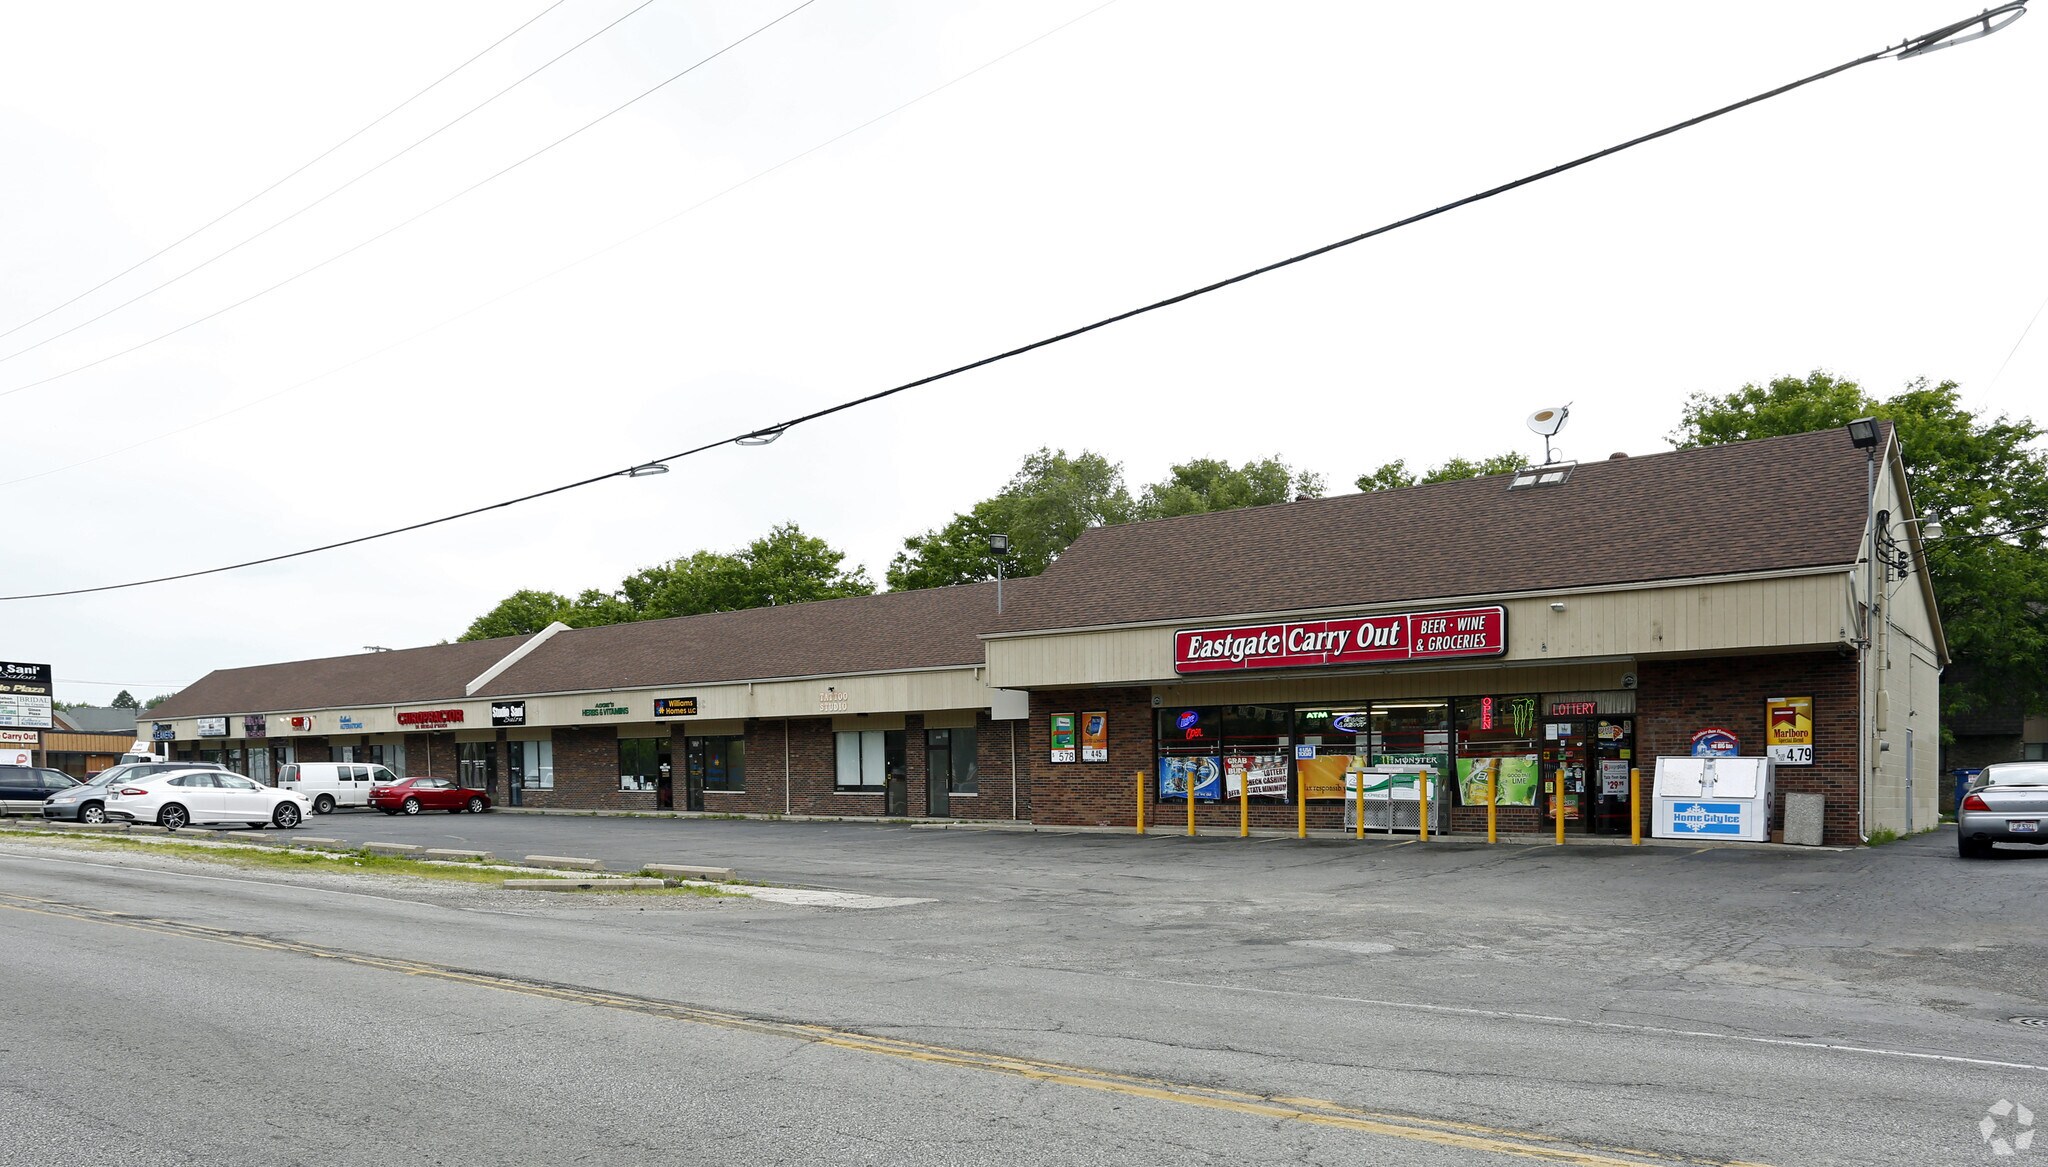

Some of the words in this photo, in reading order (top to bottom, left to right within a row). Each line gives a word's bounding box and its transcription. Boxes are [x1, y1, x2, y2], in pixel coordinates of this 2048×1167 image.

[1421, 618, 1447, 634] BEER
[1457, 615, 1486, 631] WINE
[1187, 631, 1280, 662] Eastgate
[1288, 627, 1351, 655] Carry
[1357, 620, 1401, 648] Out
[1416, 638, 1424, 652] &
[1428, 633, 1487, 651] GROCERIES
[13, 684, 46, 693] Plaza
[820, 692, 848, 701] TATTOO
[603, 707, 629, 716] VITAMINS
[665, 707, 687, 715] Homes
[820, 703, 848, 711] STUDIO
[1552, 702, 1596, 716] LOTTERY
[492, 706, 509, 718] Studio
[1306, 711, 1328, 719] ATM
[1482, 697, 1492, 730] OPEN
[397, 709, 464, 725] CHIROPRACTOR
[2, 732, 22, 740] Carry
[1774, 729, 1809, 738] Marlboro
[1059, 752, 1074, 762] 578
[1787, 747, 1812, 762] 4.79
[1227, 757, 1248, 765] GRAB
[1263, 768, 1286, 777] LOTTERY
[1263, 775, 1287, 784] CASHING
[1674, 814, 1702, 822] Home
[1703, 814, 1724, 824] City
[1724, 814, 1740, 823] Ice
